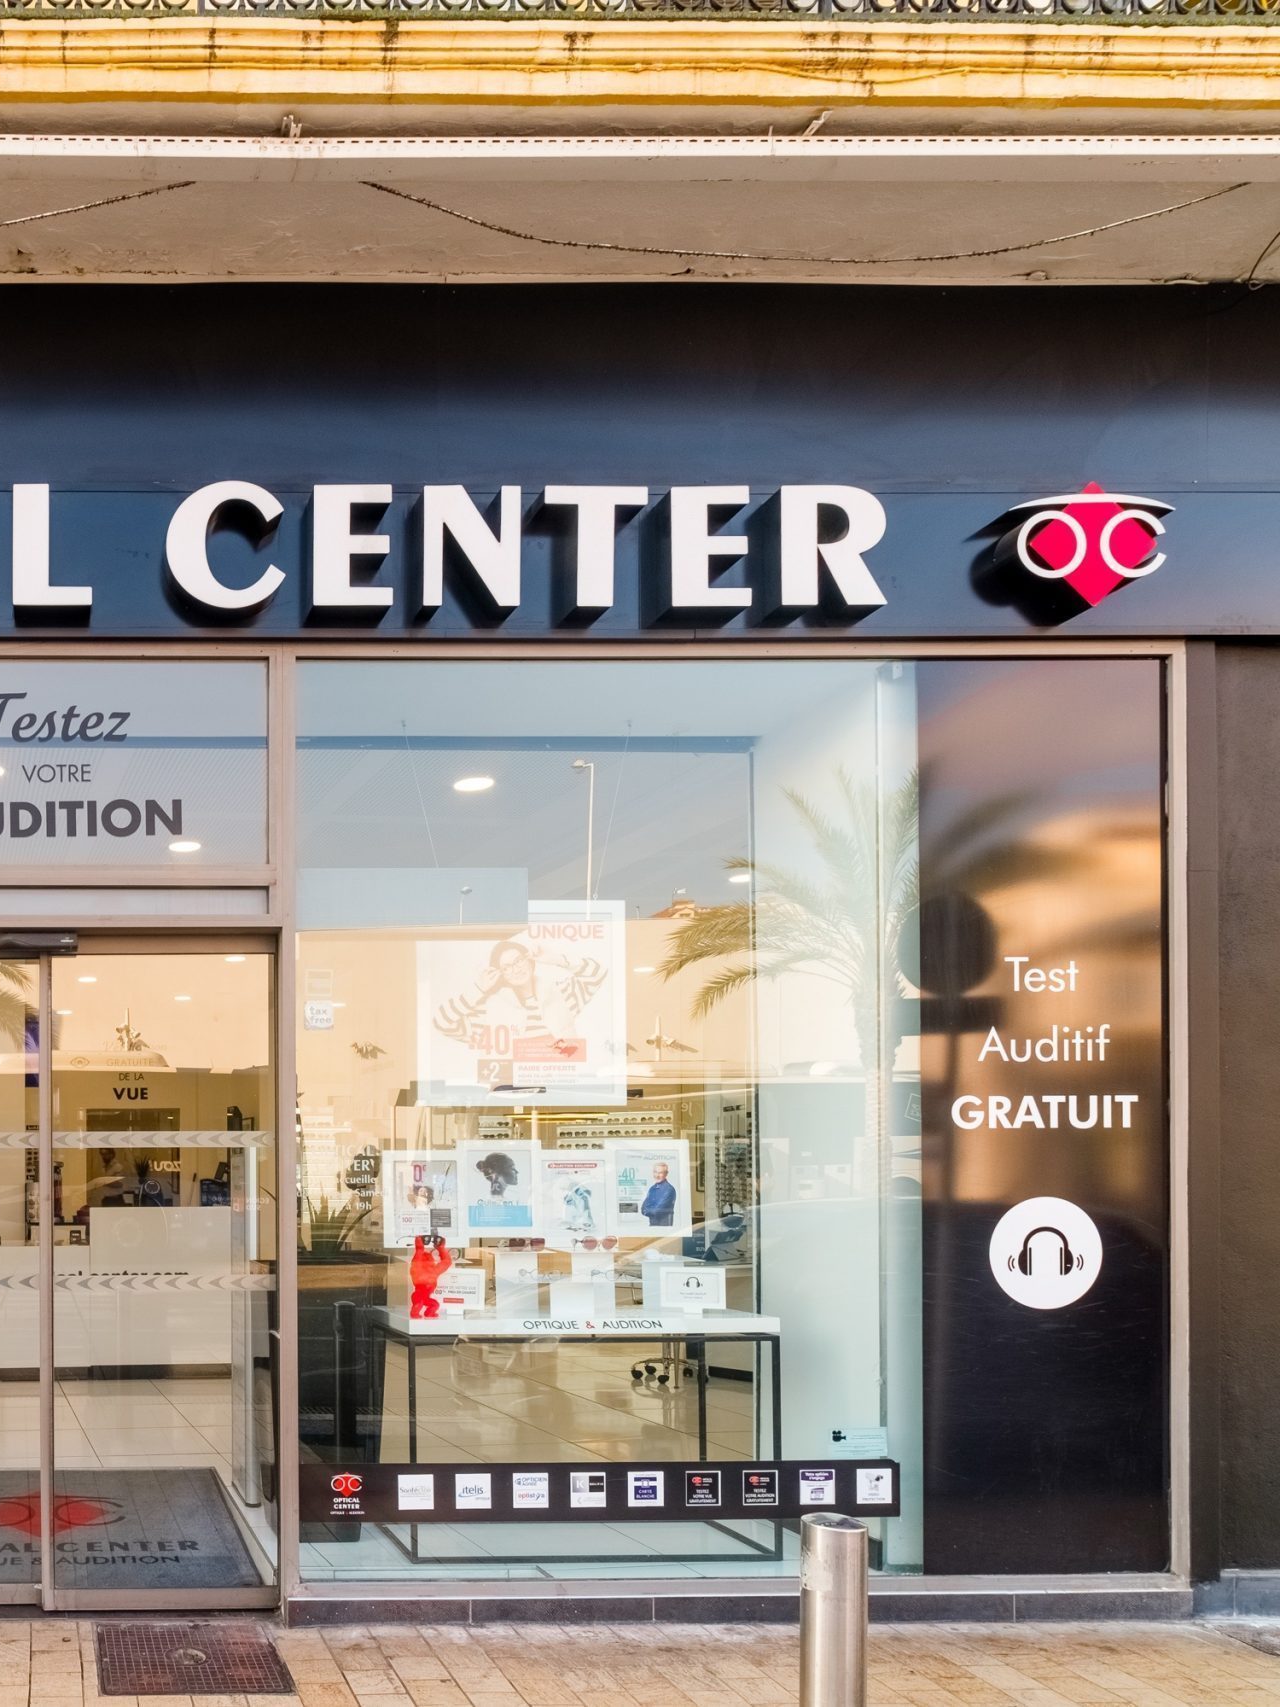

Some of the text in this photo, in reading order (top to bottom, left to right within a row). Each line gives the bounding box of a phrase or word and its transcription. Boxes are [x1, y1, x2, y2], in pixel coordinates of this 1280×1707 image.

[165, 480, 887, 608] CENTER
[22, 764, 91, 783] VOTRE
[527, 924, 604, 941] UNIQUE
[1004, 956, 1079, 993] Test
[978, 1023, 1110, 1062] Auditif
[119, 1072, 144, 1081] DE LA
[113, 1087, 149, 1100] VUE
[951, 1095, 1139, 1129] GRATUIT
[523, 1319, 663, 1330] OPTIQUE & AUDITION
[56, 1540, 201, 1553] CENTER
[56, 1555, 181, 1565] AUDITION
